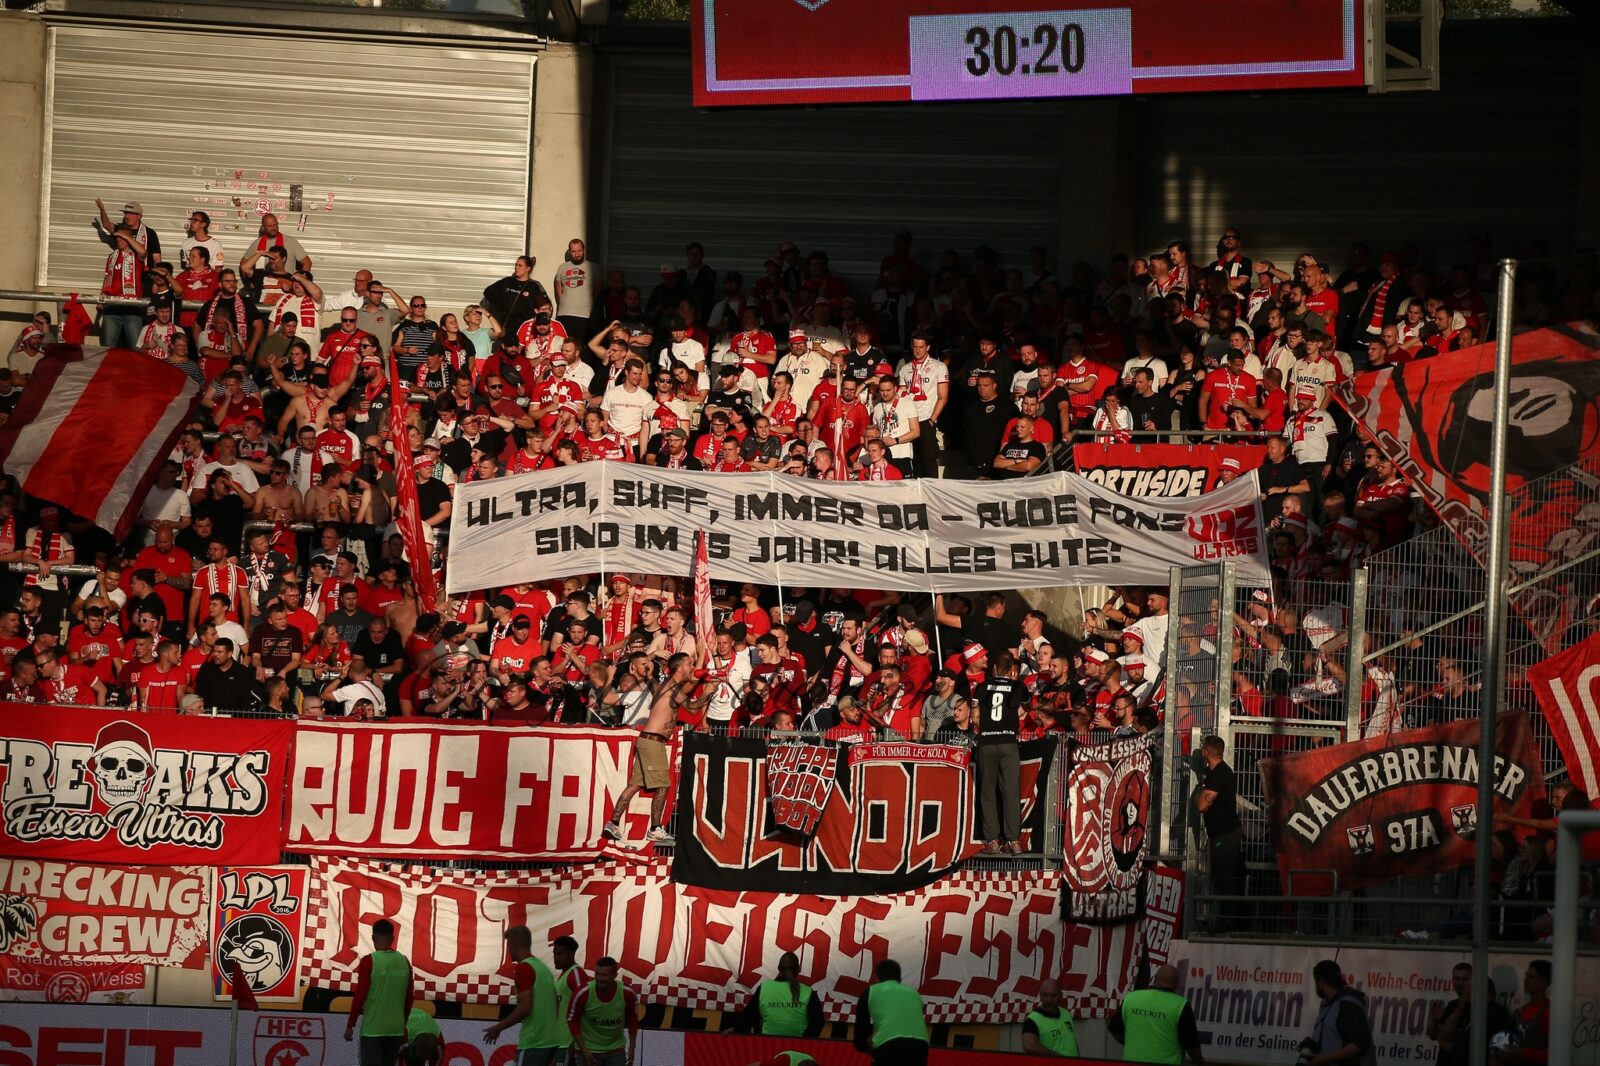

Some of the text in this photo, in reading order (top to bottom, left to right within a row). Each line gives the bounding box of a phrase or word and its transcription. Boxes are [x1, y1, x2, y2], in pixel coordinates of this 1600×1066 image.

[966, 23, 1085, 77] 30:20
[321, 445, 345, 454] steag
[467, 481, 598, 527] ULTRA,
[613, 479, 719, 524] SUFF,
[735, 492, 864, 526] IMMER
[877, 503, 928, 530] DA
[976, 494, 1079, 529] RUDE
[1090, 497, 1186, 532] FANS
[536, 523, 619, 555] SIND
[634, 525, 679, 551] IM
[748, 536, 860, 566] JAHR!
[876, 545, 996, 573] ALLES
[1010, 538, 1121, 569] GUTE!
[990, 692, 1004, 722] 8
[872, 745, 949, 759] FÜR IMMER LFC KÖLN
[0, 740, 270, 814] REAKS
[288, 730, 480, 846] RUDE
[6, 795, 224, 848] Essen Ultras
[1387, 818, 1440, 853] 97A
[219, 872, 298, 910] LPL
[1072, 887, 1138, 921] ULTRAS
[41, 914, 176, 954] CREW
[6, 967, 143, 987] Rot Weiss
[1216, 965, 1302, 985] Wohn-Centrum
[1367, 972, 1457, 993] Wohn-Centru
[268, 1018, 313, 1036] HFC
[1130, 1008, 1167, 1020] SECURITY
[1217, 1032, 1298, 1051] an der Saline
[1374, 1042, 1440, 1061] n der Sal
